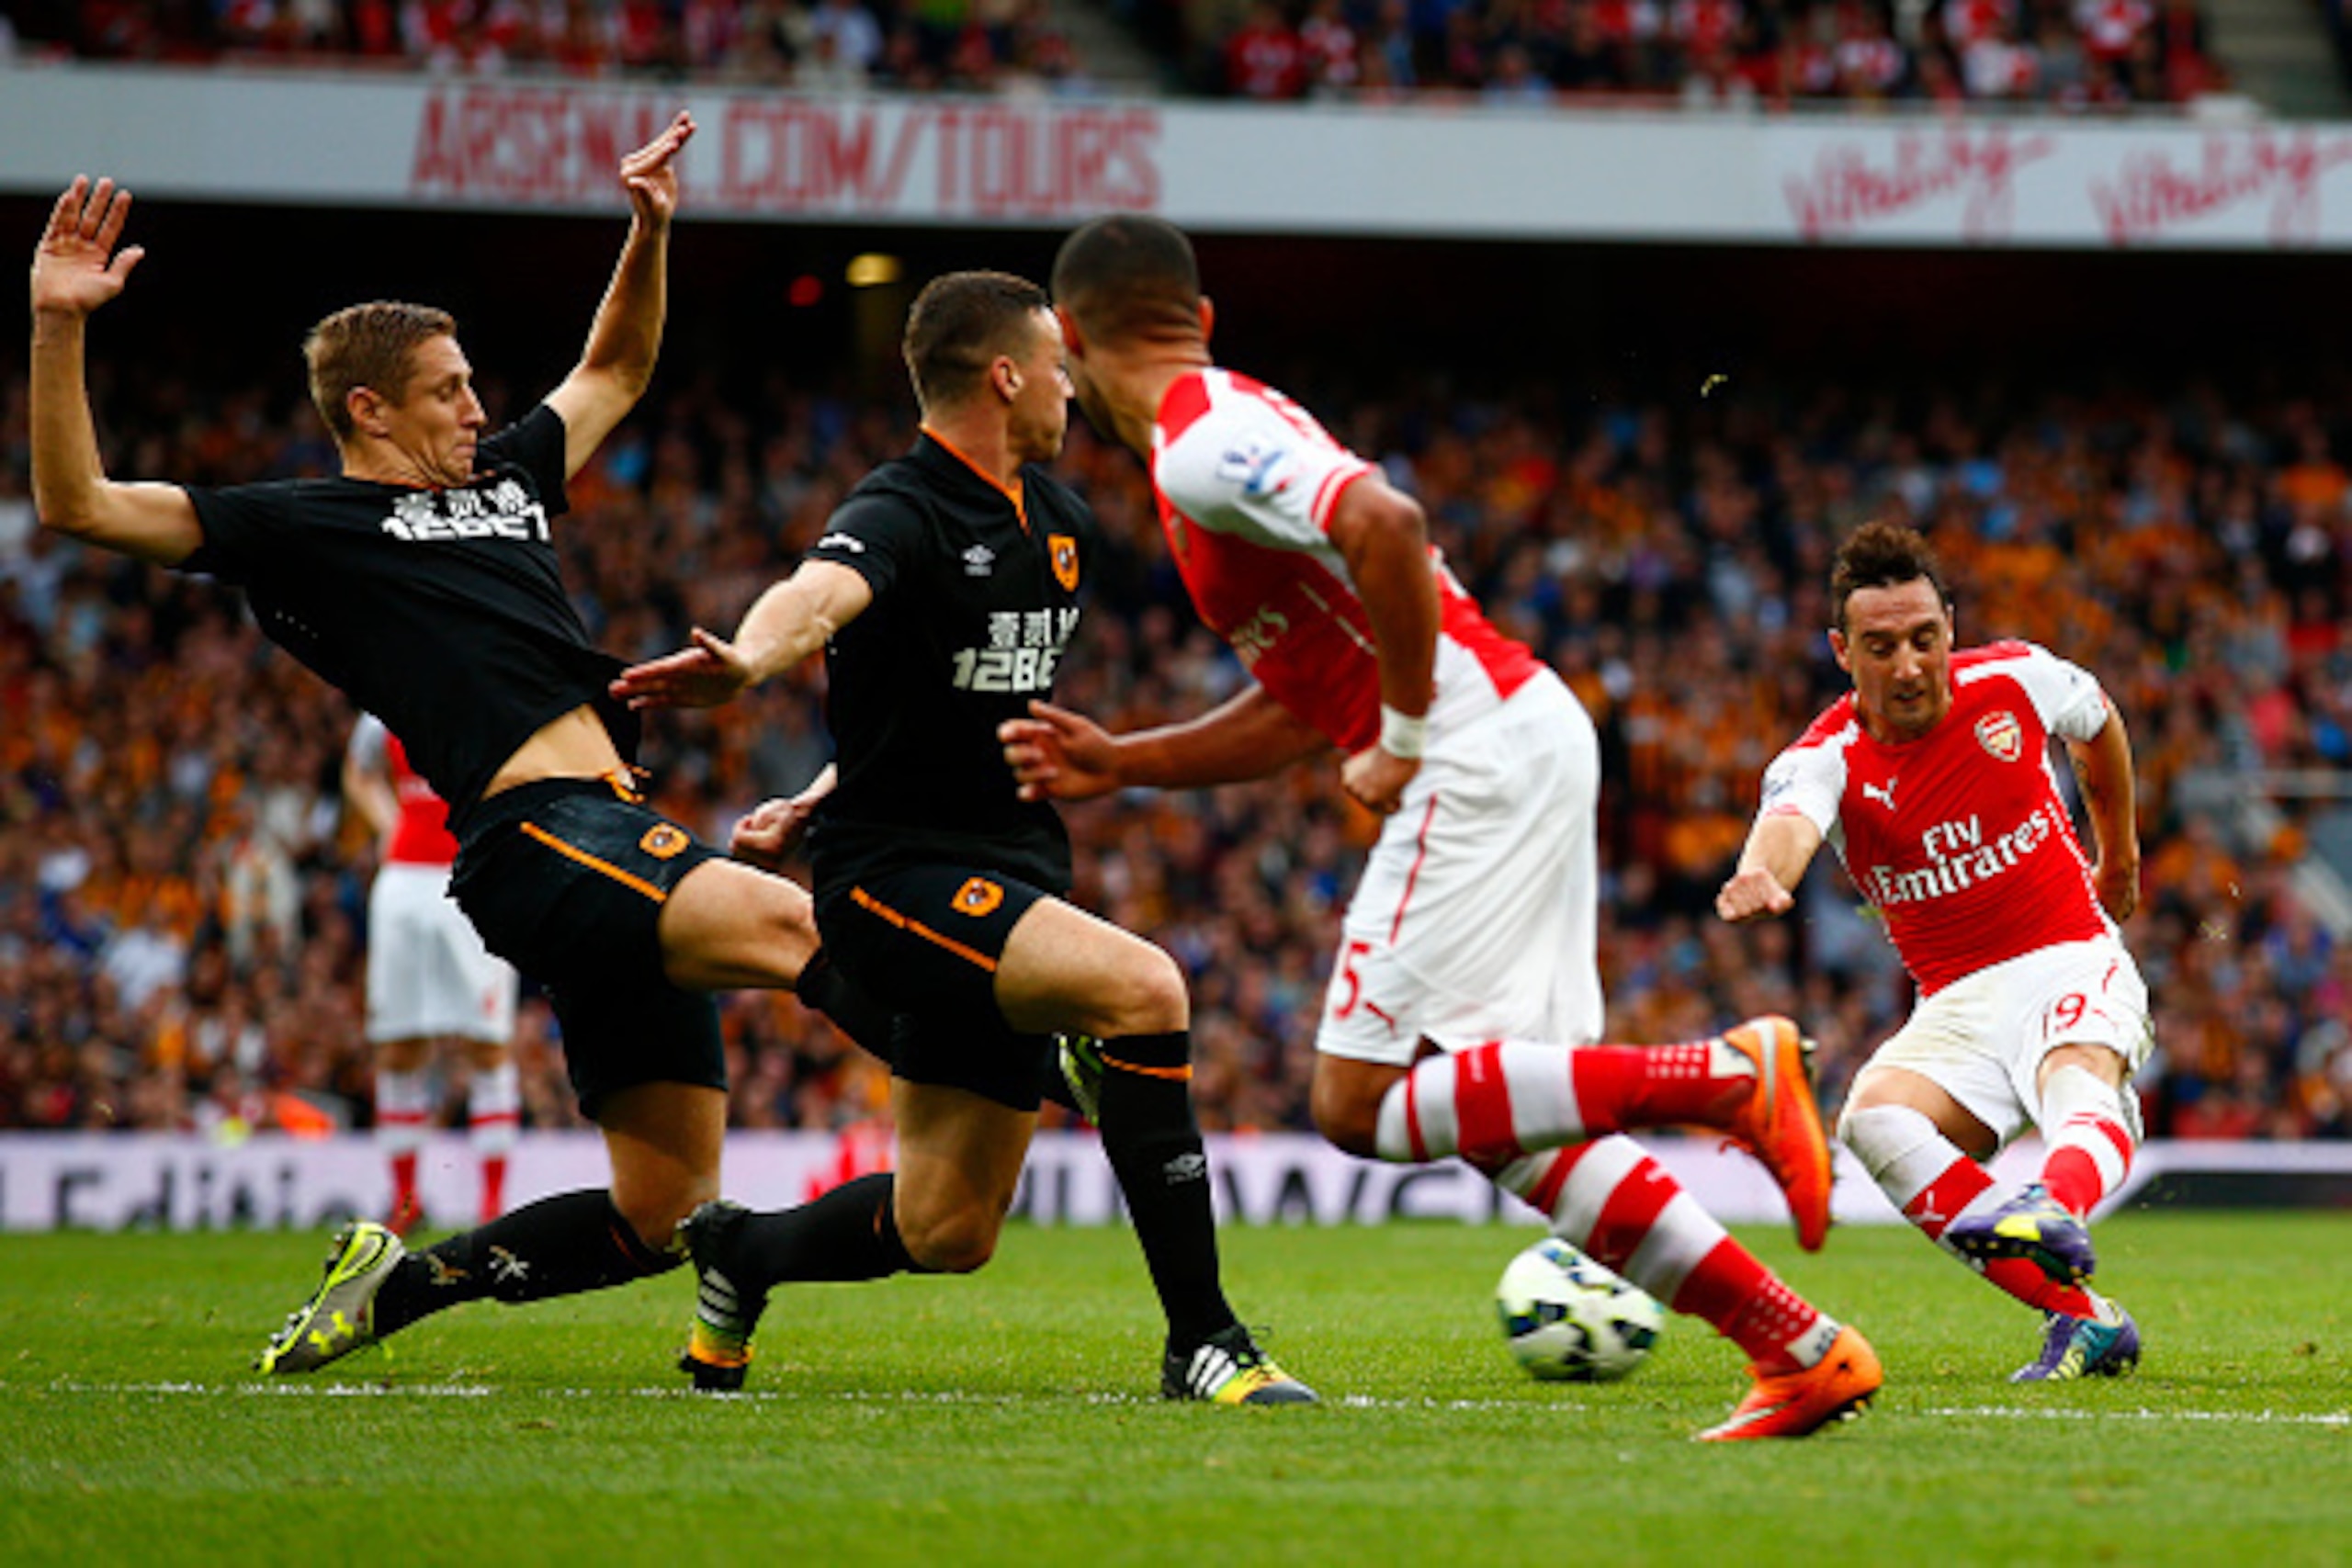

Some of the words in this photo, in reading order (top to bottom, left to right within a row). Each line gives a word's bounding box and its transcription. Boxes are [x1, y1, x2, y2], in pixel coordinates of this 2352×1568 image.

[952, 647, 1064, 692] 12BE
[1871, 809, 2050, 905] Emirates
[1922, 813, 1982, 862] Fly
[2040, 991, 2087, 1043] 19
